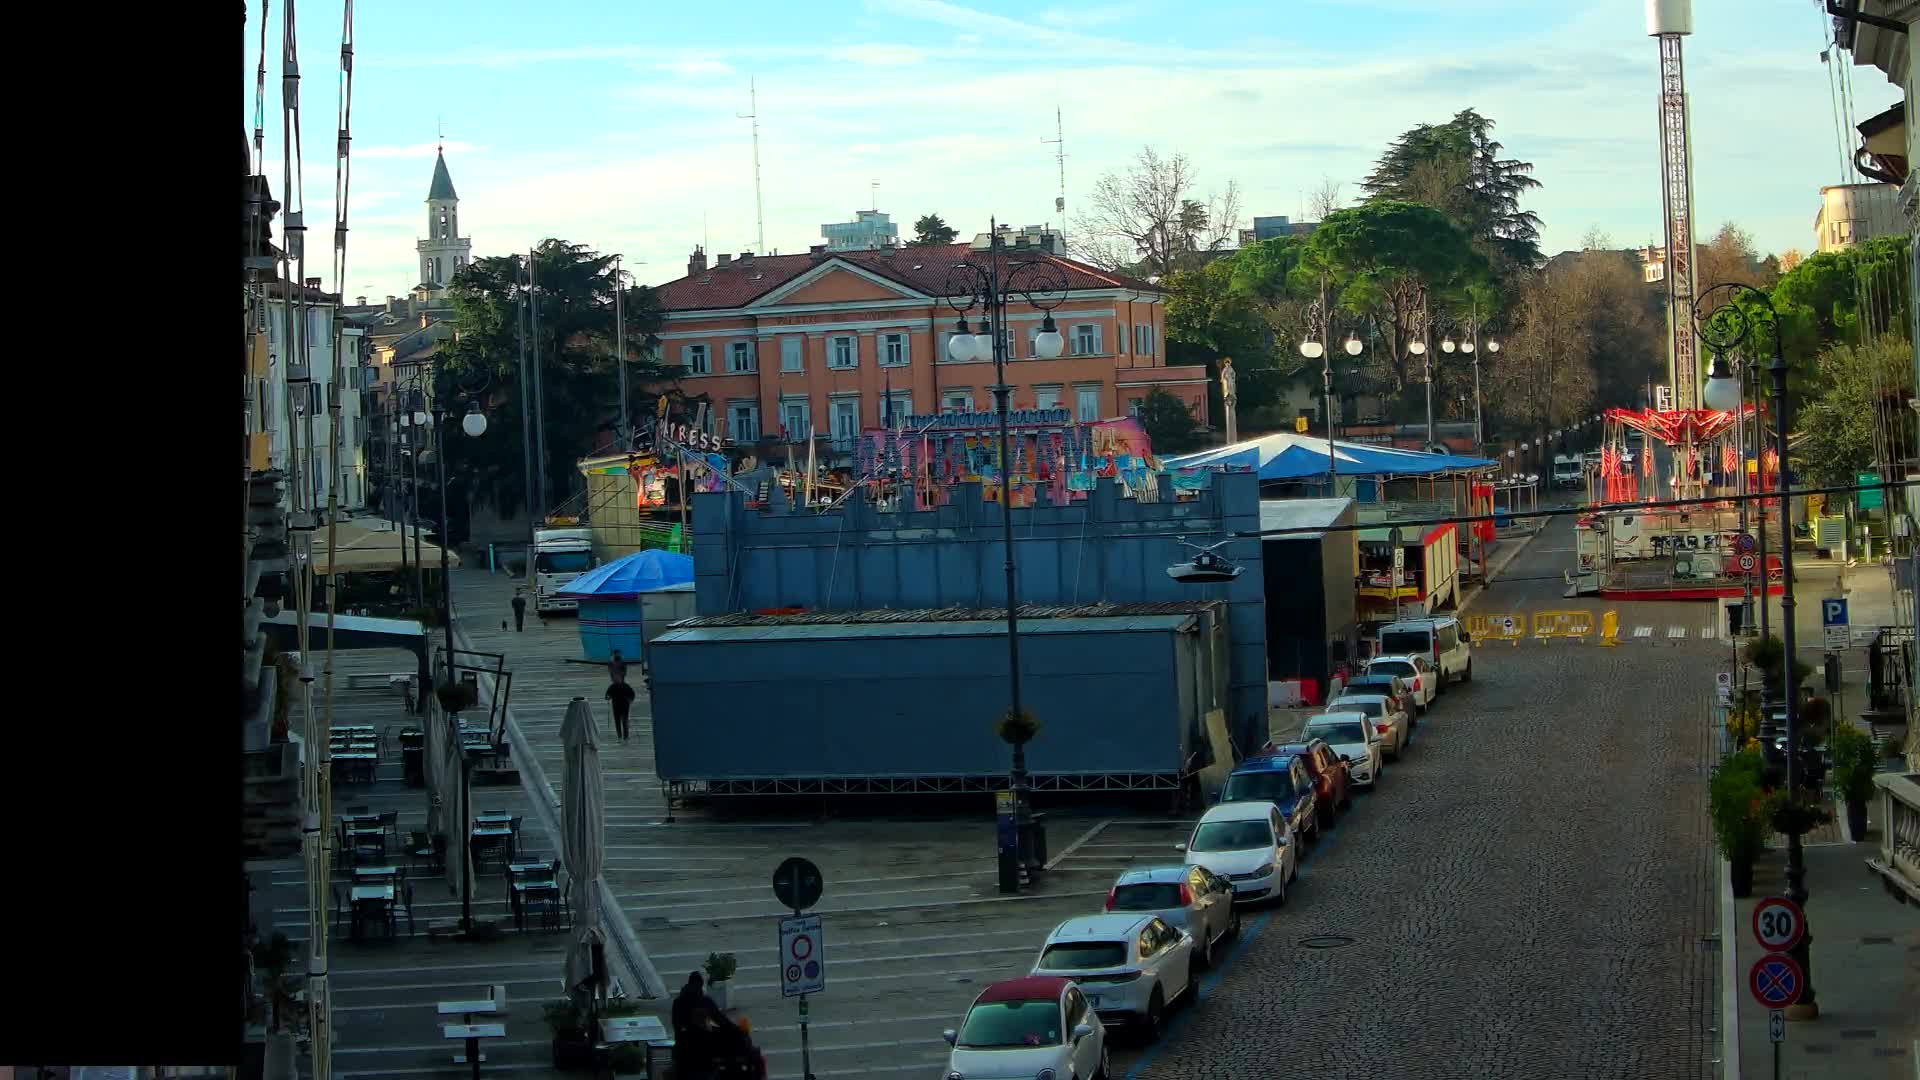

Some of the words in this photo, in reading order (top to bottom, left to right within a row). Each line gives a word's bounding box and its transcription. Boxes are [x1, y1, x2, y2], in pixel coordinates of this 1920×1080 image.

[1742, 557, 1753, 567] 20
[1827, 602, 1842, 621] P
[1762, 911, 1792, 938] 30
